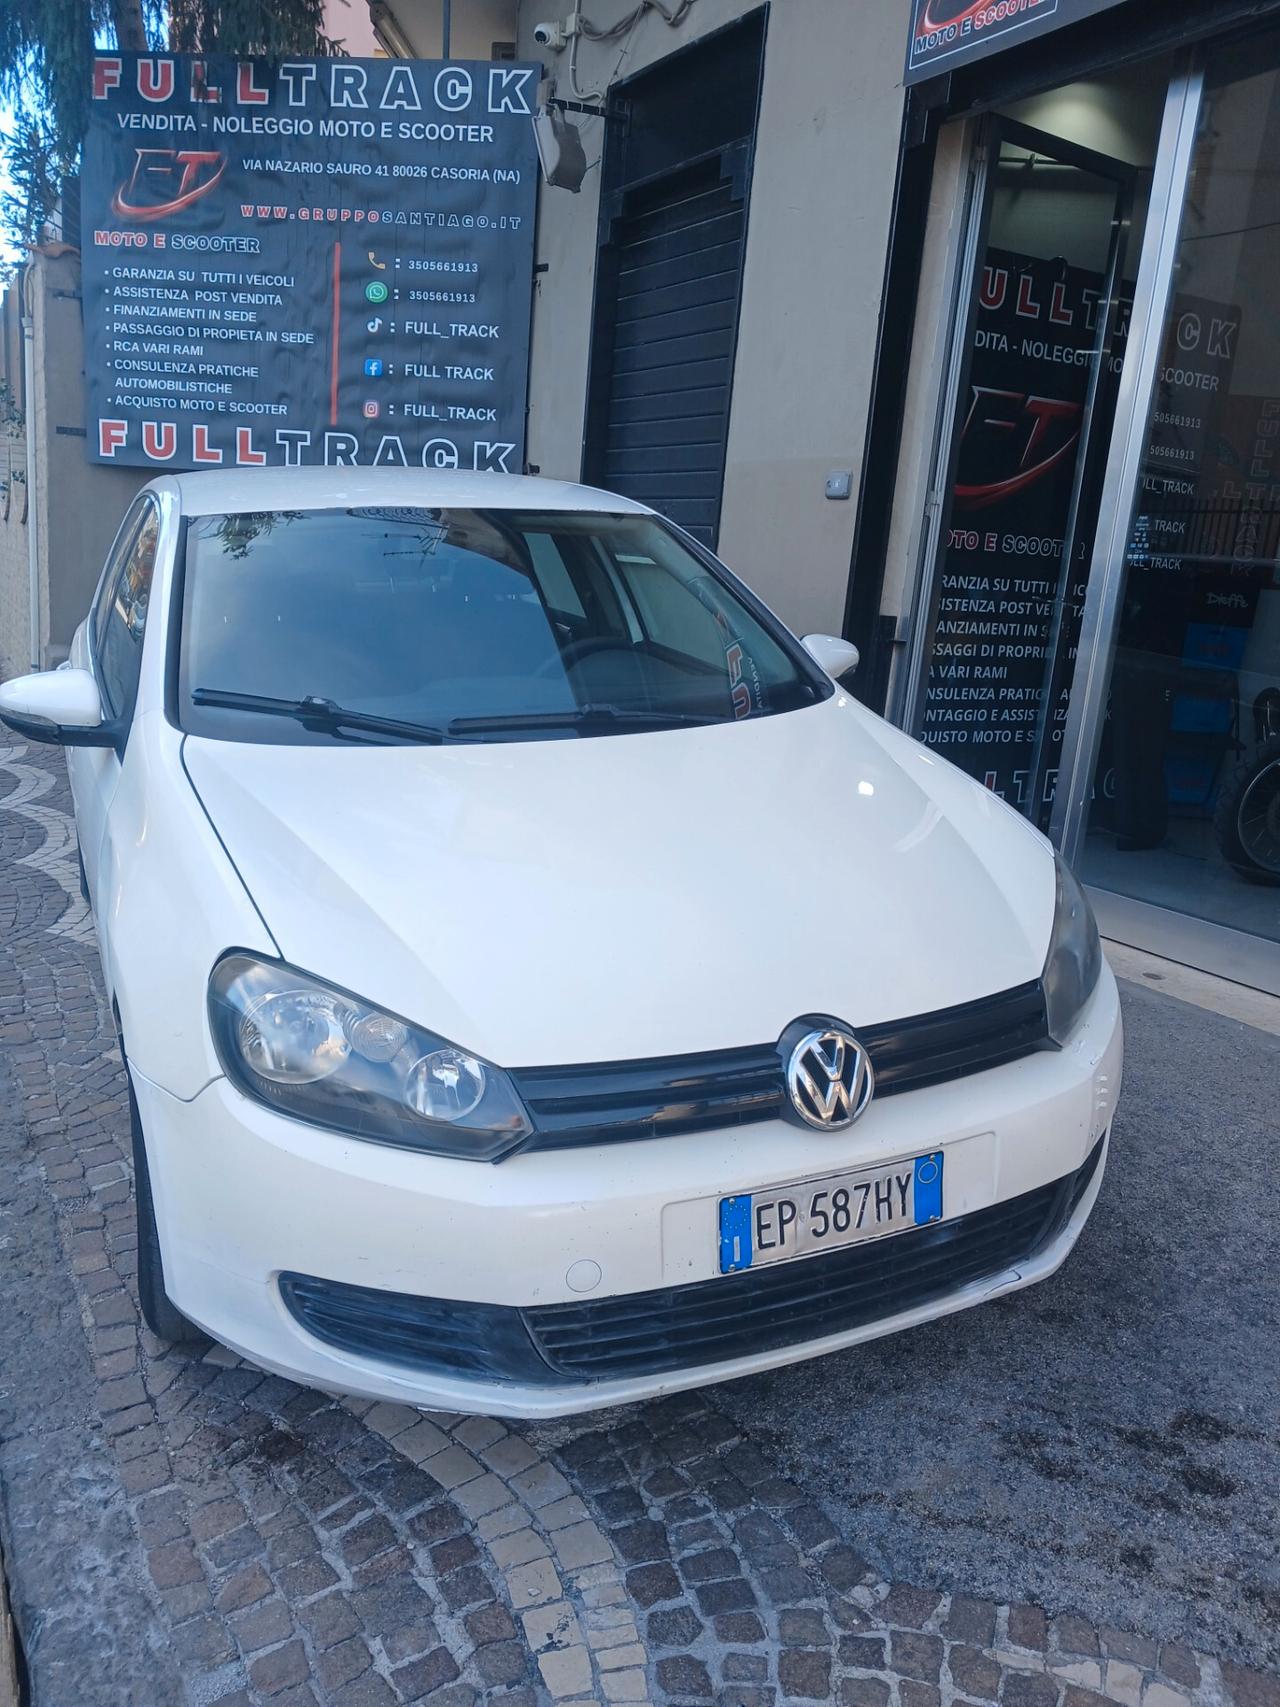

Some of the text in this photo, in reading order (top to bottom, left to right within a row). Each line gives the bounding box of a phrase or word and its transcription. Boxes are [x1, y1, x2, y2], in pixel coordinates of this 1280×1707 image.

[914, 25, 957, 54] MOTO
[960, 16, 973, 36] E
[92, 57, 534, 115] FULLTRACK
[117, 113, 196, 132] VENDITA
[213, 116, 314, 135] NOLEGGIO
[319, 119, 375, 138] MOTO
[381, 121, 393, 138] E
[398, 122, 494, 143] SCOOTER
[243, 159, 521, 185] VIA NAZARIO SAURO 41 80026 CASORIA (NA)
[240, 204, 522, 230] WWW.GRUPPOSANTIAGO.IT
[94, 230, 260, 254] MOTO E SCOOTER
[408, 259, 479, 273] 3505661913
[112, 267, 175, 281] GARANZIA
[178, 270, 195, 282] SU
[201, 271, 236, 285] TUTTI
[246, 274, 295, 288] VEICOLI
[113, 285, 283, 306] ASSISTENZA POST VENDITA
[408, 290, 476, 303] 3505661913
[113, 304, 257, 323] FINANZIAMENTI IN SEDE
[113, 322, 315, 345] PASSAGGIO DI PROPIETA IN SEDE
[404, 320, 500, 339] FULL_TRACK
[113, 340, 204, 356] RCA VARI RAMI
[974, 329, 1009, 353] DITA
[1021, 338, 1091, 368] NOLEGGI
[114, 358, 259, 378] CONSULENZA PRATICHE
[404, 363, 441, 378] FULL
[444, 365, 494, 381] TRACK
[115, 376, 233, 395] AUTOMOBILISTICHE
[115, 394, 288, 416] ACQUISTO MOTO E SCOOTER
[403, 403, 497, 422] FULL_TRACK
[1152, 411, 1201, 430] 505661913
[98, 418, 516, 474] FULLTRACK
[1149, 443, 1195, 461] 505661913
[1155, 519, 1186, 535] TRACK
[984, 532, 998, 552] E
[942, 574, 990, 591] RANZIA
[992, 578, 1010, 591] SU
[1014, 579, 1050, 595] TUTTI
[1000, 601, 1033, 616] POST
[936, 620, 1020, 637] ANZIAMENTI
[1023, 623, 1038, 637] IN
[980, 644, 995, 657] DI
[998, 645, 1046, 659] PROPRI
[939, 665, 970, 679] VARI
[974, 666, 1008, 680] RAMI
[926, 687, 996, 700] NSULENZA
[998, 687, 1043, 701] PRATIC
[924, 708, 988, 722] NTAGGIO
[991, 709, 999, 721] E
[972, 730, 1012, 743] MOTO
[1014, 730, 1024, 743] E
[756, 1173, 912, 1250] EP 587HY
